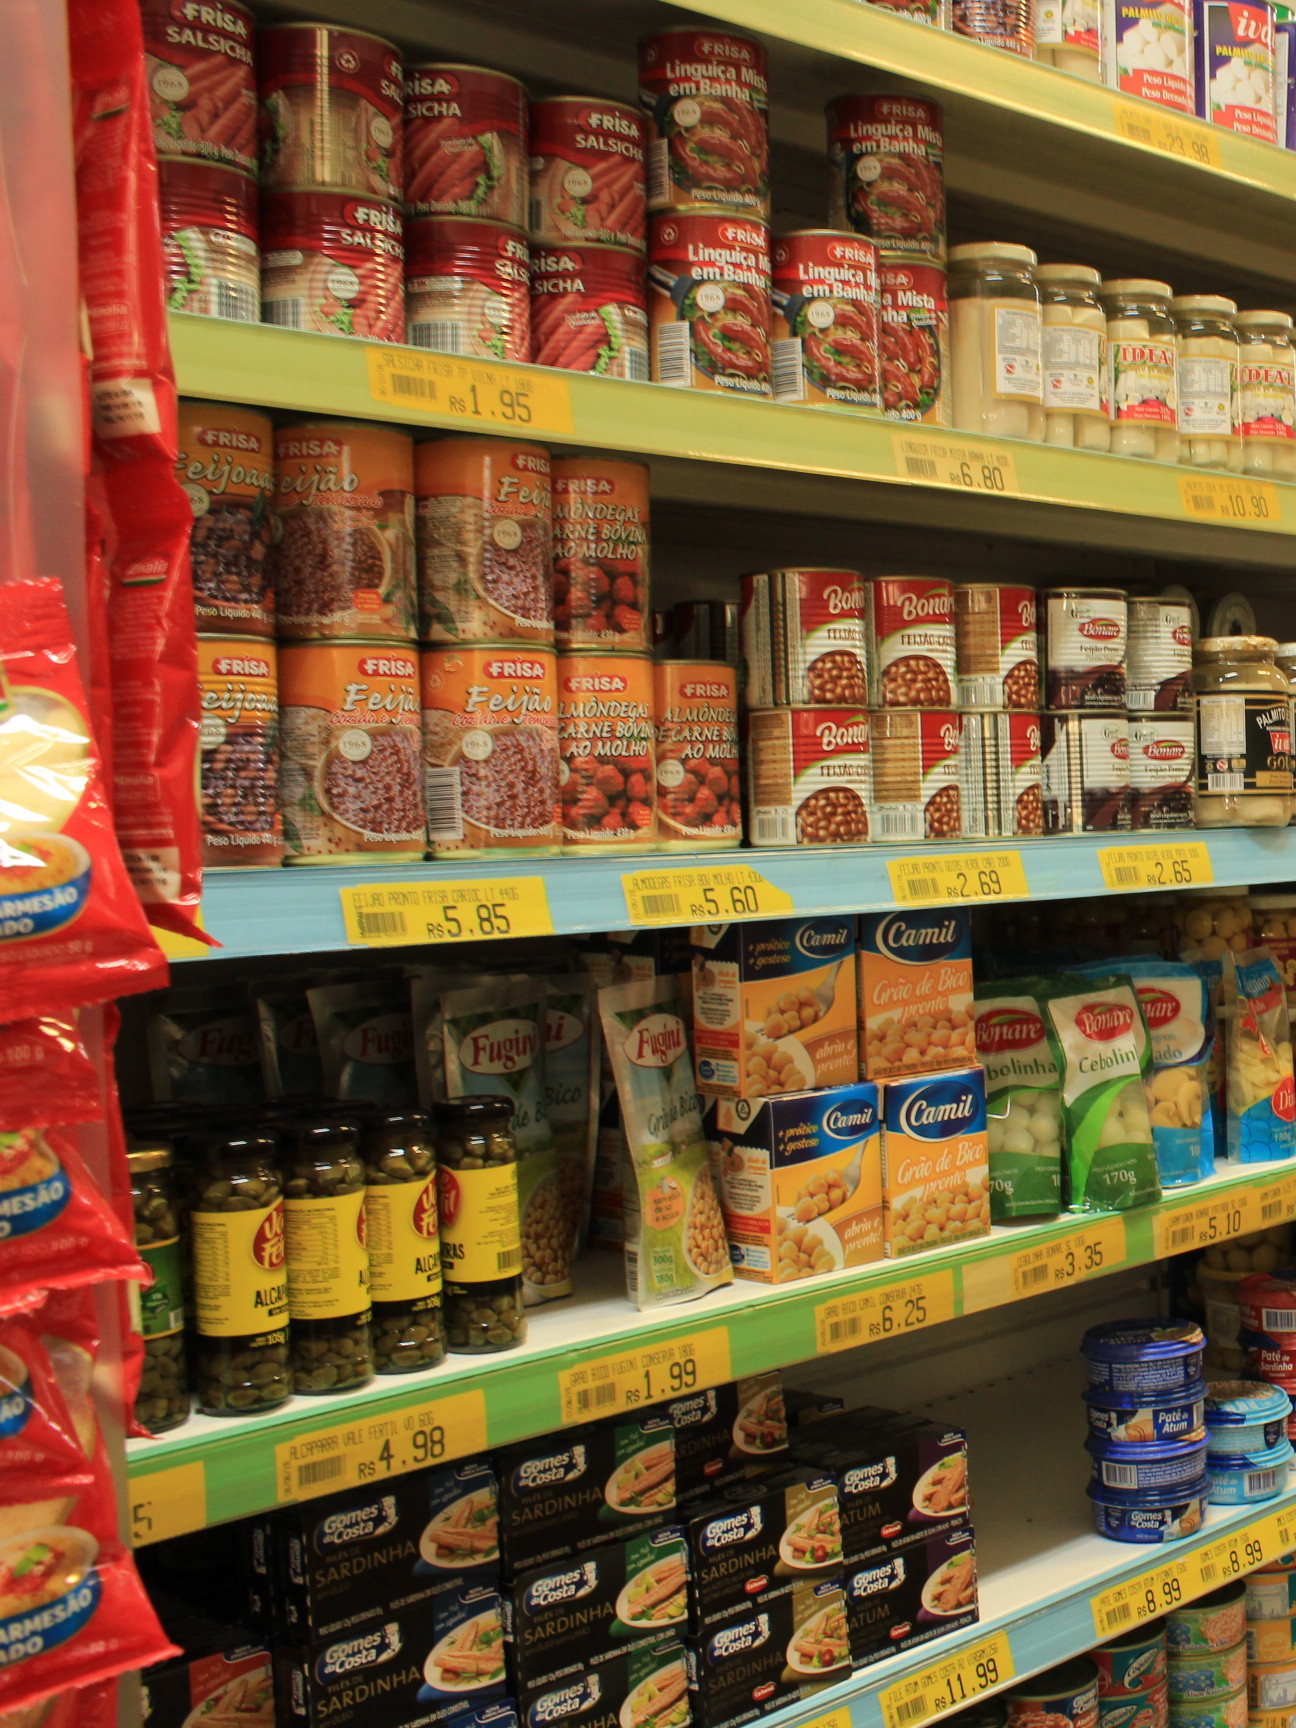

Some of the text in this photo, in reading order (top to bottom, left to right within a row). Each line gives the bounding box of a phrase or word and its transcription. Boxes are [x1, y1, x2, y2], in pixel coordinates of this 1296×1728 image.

[167, 25, 253, 66] SALSICHA
[666, 58, 737, 83] Linguiça
[669, 78, 750, 101] em Banha
[850, 121, 912, 141] Linguiça
[576, 134, 643, 161] SALSICHA
[853, 139, 926, 158] em Banha
[1166, 133, 1210, 165] 23.98
[688, 243, 756, 270] Linguiça
[692, 266, 766, 288] em Banha
[799, 262, 863, 287] Linguiça
[802, 282, 876, 304] em Banha
[897, 290, 935, 310] Mista
[449, 384, 532, 423] R$ 1.95
[204, 429, 260, 452] FRISA
[960, 463, 1005, 491] 6.80
[1229, 494, 1269, 518] 10.90
[582, 544, 637, 561] MOLHO
[217, 656, 269, 676] FRISA
[363, 653, 415, 677] FRISA
[489, 655, 544, 678] FRISA
[568, 672, 626, 692] FRISA
[683, 680, 730, 698] FRISA
[464, 685, 552, 725] Feijão
[330, 710, 376, 726] Cozido
[453, 713, 496, 728] Cozido
[1256, 707, 1286, 730] PALMITO
[671, 725, 720, 743] CARNE
[566, 740, 647, 758] AO MOLHO
[681, 744, 704, 760] AO
[207, 836, 229, 847] Peso
[957, 870, 1003, 897] 2.69
[1155, 860, 1193, 885] 2.65
[422, 890, 449, 906] FRISA
[703, 886, 760, 916] 5.60
[427, 903, 511, 940] R$ 5.85
[888, 919, 957, 949] Camil
[801, 927, 849, 949] Camil
[873, 967, 969, 1005] Grão de Bico
[900, 995, 950, 1024] pronto
[1083, 1002, 1134, 1034] Bonare
[636, 1020, 683, 1063] Fugini
[976, 1015, 1042, 1047] Bonare
[828, 1108, 874, 1130] Camil
[909, 1094, 974, 1125] Camil
[785, 1122, 819, 1140] prático
[785, 1137, 820, 1155] gostoso
[897, 1142, 985, 1185] Grão de Bico
[922, 1172, 966, 1203] pronto
[1102, 1168, 1137, 1187] 170g
[1207, 1210, 1242, 1237] 5.10
[1054, 1242, 1103, 1282] R$ 3.35
[868, 1296, 928, 1337] R$ 6.25
[1260, 1361, 1294, 1372] Sardinha
[1261, 1350, 1281, 1363] Patê
[624, 1358, 698, 1405] R$ 1.99
[1158, 1409, 1181, 1425] Patê
[1162, 1420, 1188, 1434] Atum
[342, 1427, 365, 1449] VALE
[366, 1417, 400, 1443] FERTIL
[357, 1424, 446, 1481] R$ 4.98
[519, 1453, 570, 1479] Gomes
[529, 1469, 566, 1488] Costa
[844, 1462, 884, 1485] Gomes
[851, 1476, 881, 1493] Costa
[323, 1503, 379, 1532] Gomes
[707, 1513, 749, 1538] Gomes
[842, 1502, 882, 1527] ATUM
[1131, 1511, 1162, 1524] Gomes
[1137, 1517, 1159, 1530] Costa
[333, 1521, 374, 1546] Costa
[714, 1527, 745, 1548] Costa
[314, 1541, 417, 1588] SARDINHA
[701, 1544, 781, 1584] SARDINHA
[1230, 1539, 1263, 1574] 8.99
[531, 1570, 581, 1597] Gomes
[853, 1563, 893, 1589] Gomes
[860, 1577, 889, 1595] Costa
[540, 1585, 577, 1607] Costa
[1136, 1578, 1183, 1619] R$ 8.99
[524, 1601, 614, 1646] SARDINHA
[851, 1605, 891, 1632] ATUM
[325, 1632, 382, 1660] Gomes
[713, 1622, 757, 1648] Gomes
[720, 1635, 753, 1656] Costa
[708, 1652, 784, 1694] SARDINHA
[945, 1658, 1000, 1707] 11.99
[316, 1666, 421, 1718] SARDINHA
[535, 1683, 584, 1711] Gomes
